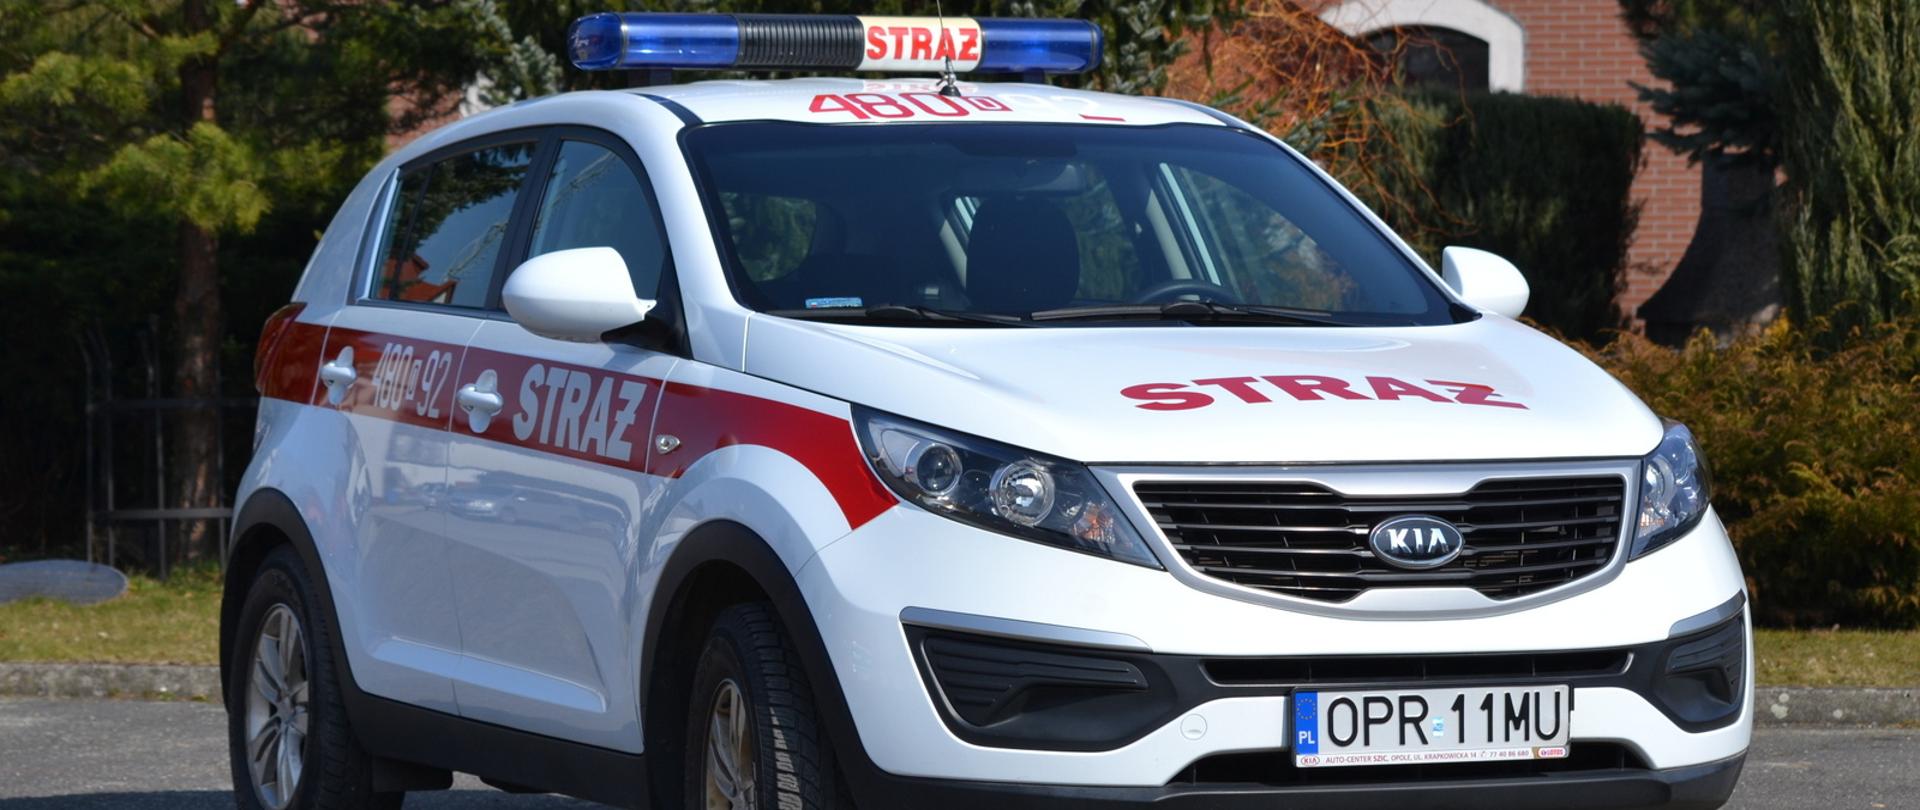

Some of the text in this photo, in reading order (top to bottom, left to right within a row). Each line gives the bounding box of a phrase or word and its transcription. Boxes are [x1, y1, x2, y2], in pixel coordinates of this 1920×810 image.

[1387, 528, 1450, 554] KIA
[1298, 690, 1562, 748] PL OPR 11MU
[1303, 756, 1318, 765] KIA
[1325, 755, 1372, 764] AUTO-CENTER
